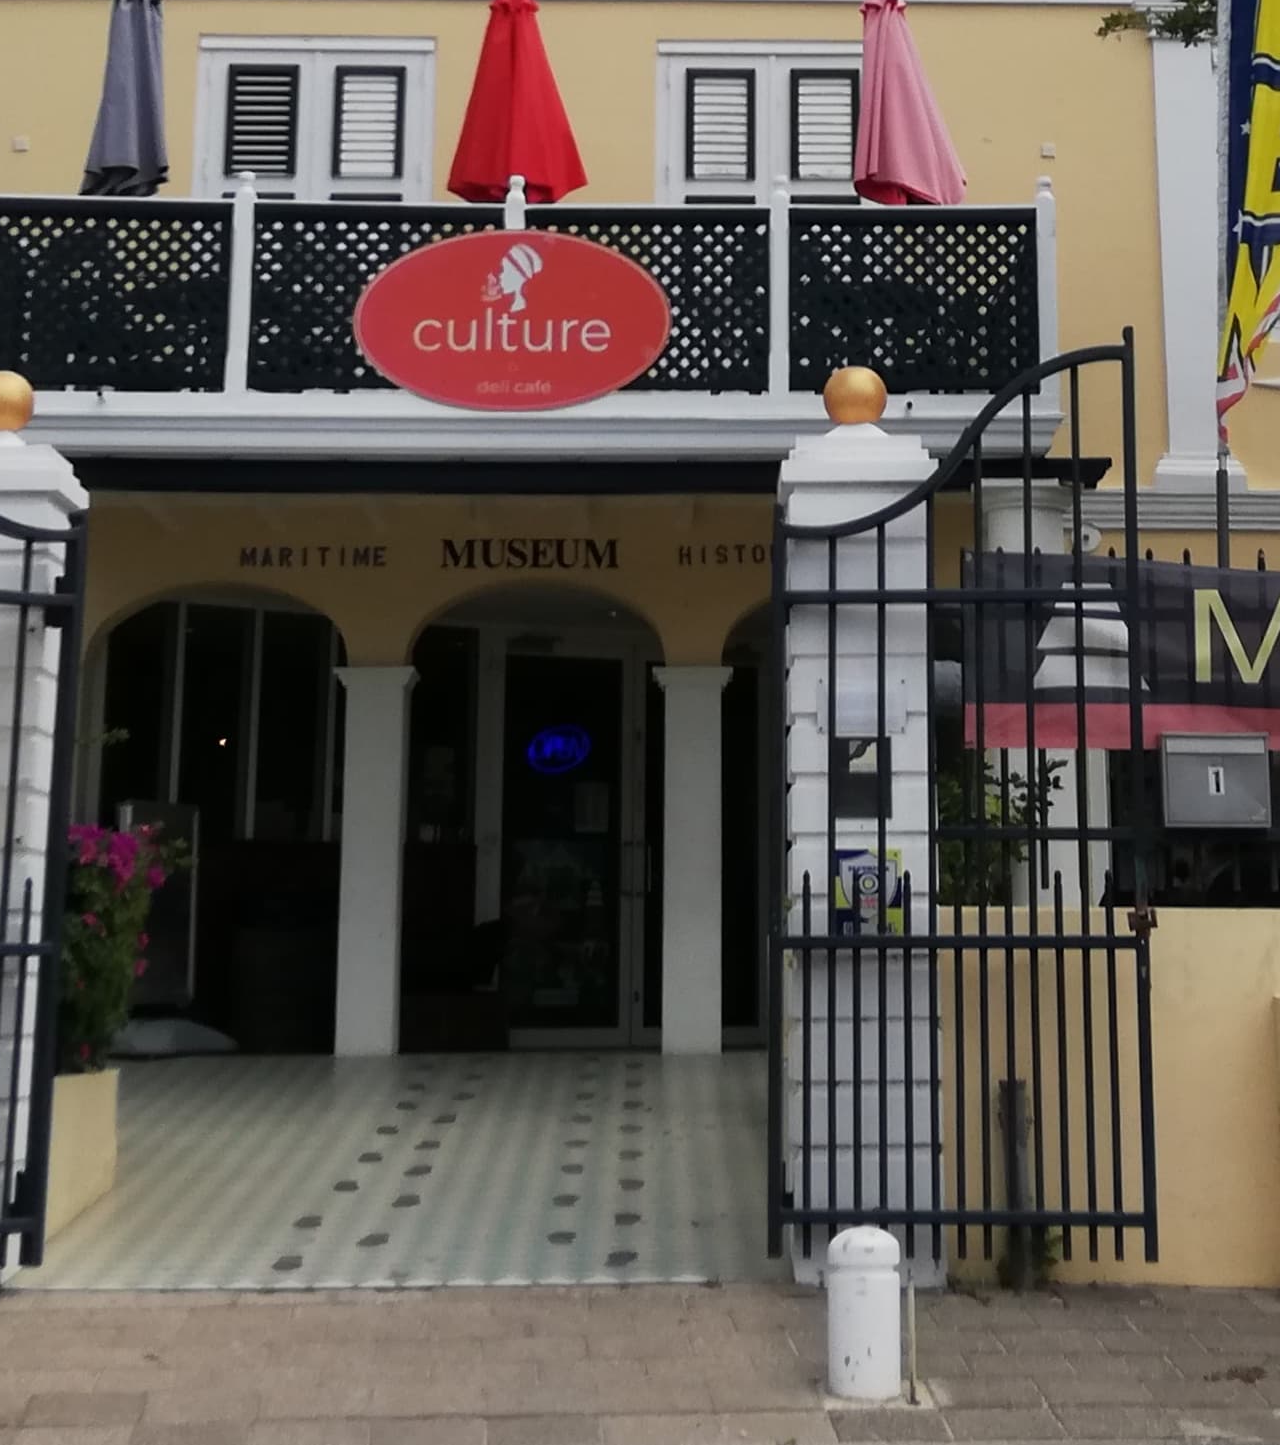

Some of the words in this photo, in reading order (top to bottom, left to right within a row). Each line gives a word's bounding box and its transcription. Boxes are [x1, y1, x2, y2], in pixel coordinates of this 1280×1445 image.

[413, 307, 611, 353] culture
[477, 380, 510, 394] deli
[239, 545, 388, 568] MARITIME
[440, 537, 619, 570] MUSEUM
[678, 543, 772, 566] HISTO
[1212, 769, 1221, 794] 1
